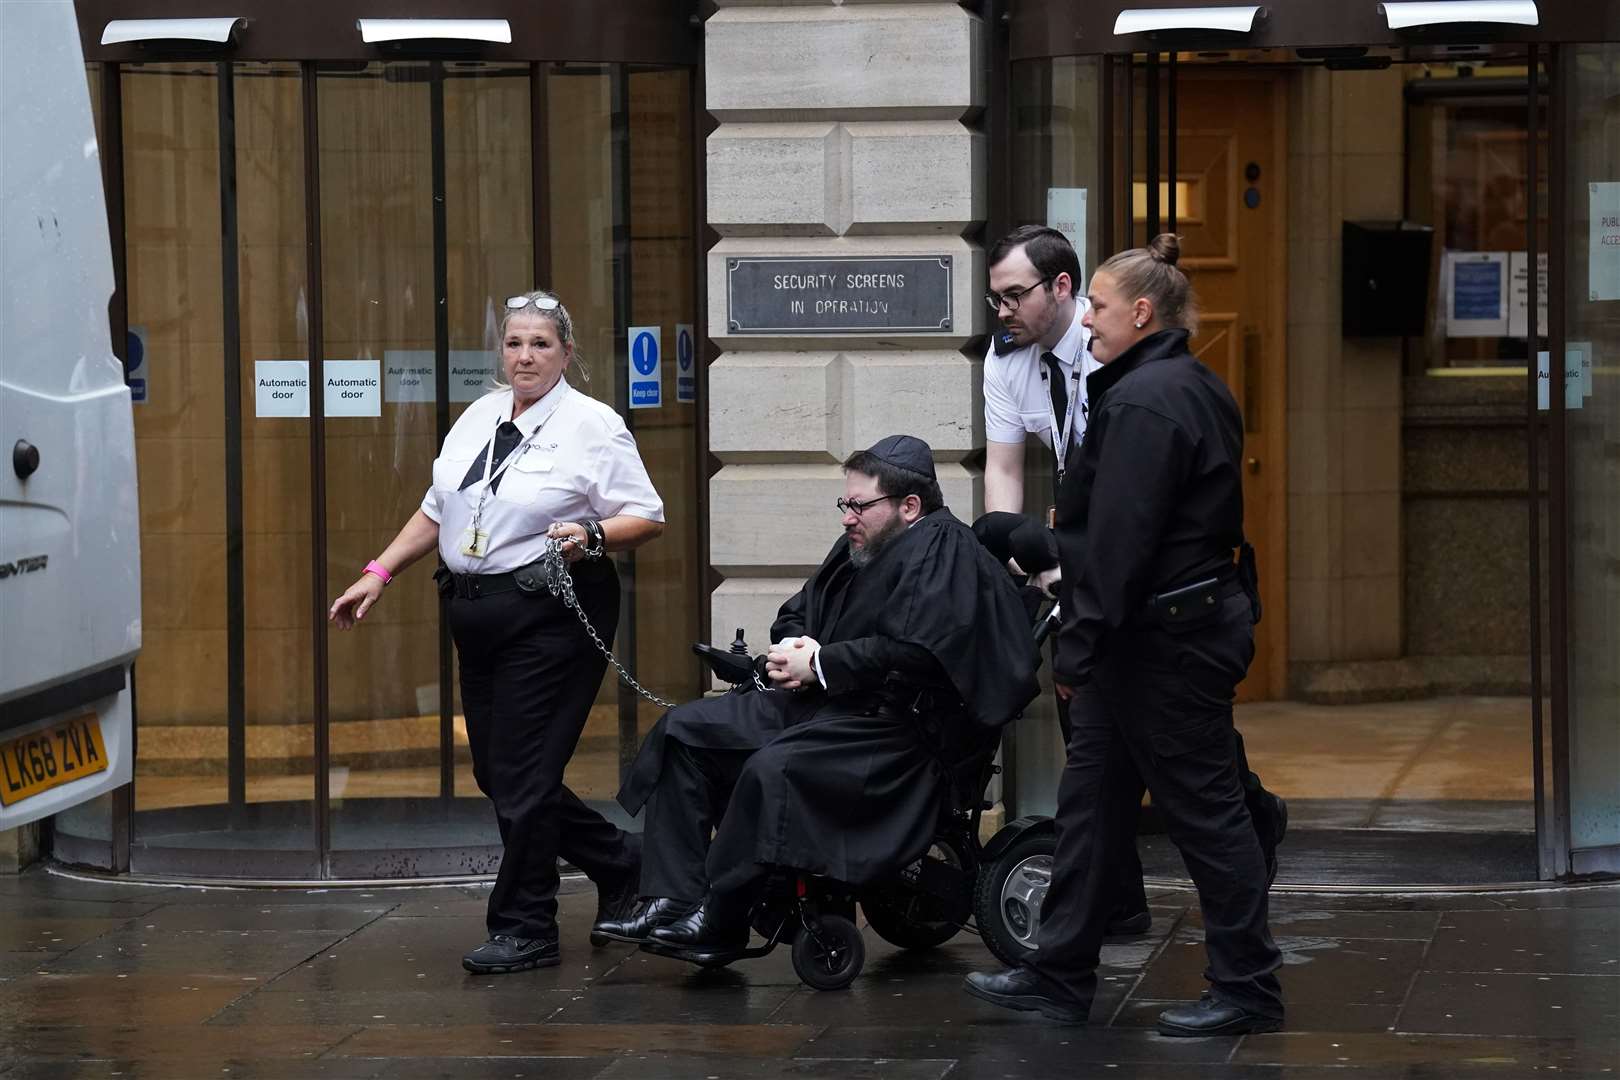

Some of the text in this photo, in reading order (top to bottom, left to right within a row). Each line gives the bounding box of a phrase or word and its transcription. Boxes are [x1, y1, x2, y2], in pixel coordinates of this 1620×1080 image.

[774, 274, 905, 290] SECURITY SCREENS
[791, 300, 888, 314] IN OPERATION
[451, 367, 496, 375] Automatic
[259, 378, 307, 387] Automatic
[327, 378, 377, 387] Automatic
[464, 378, 483, 386] door
[272, 391, 294, 399] door
[341, 391, 364, 399] door
[1, 722, 98, 792] LK68 ZVA
